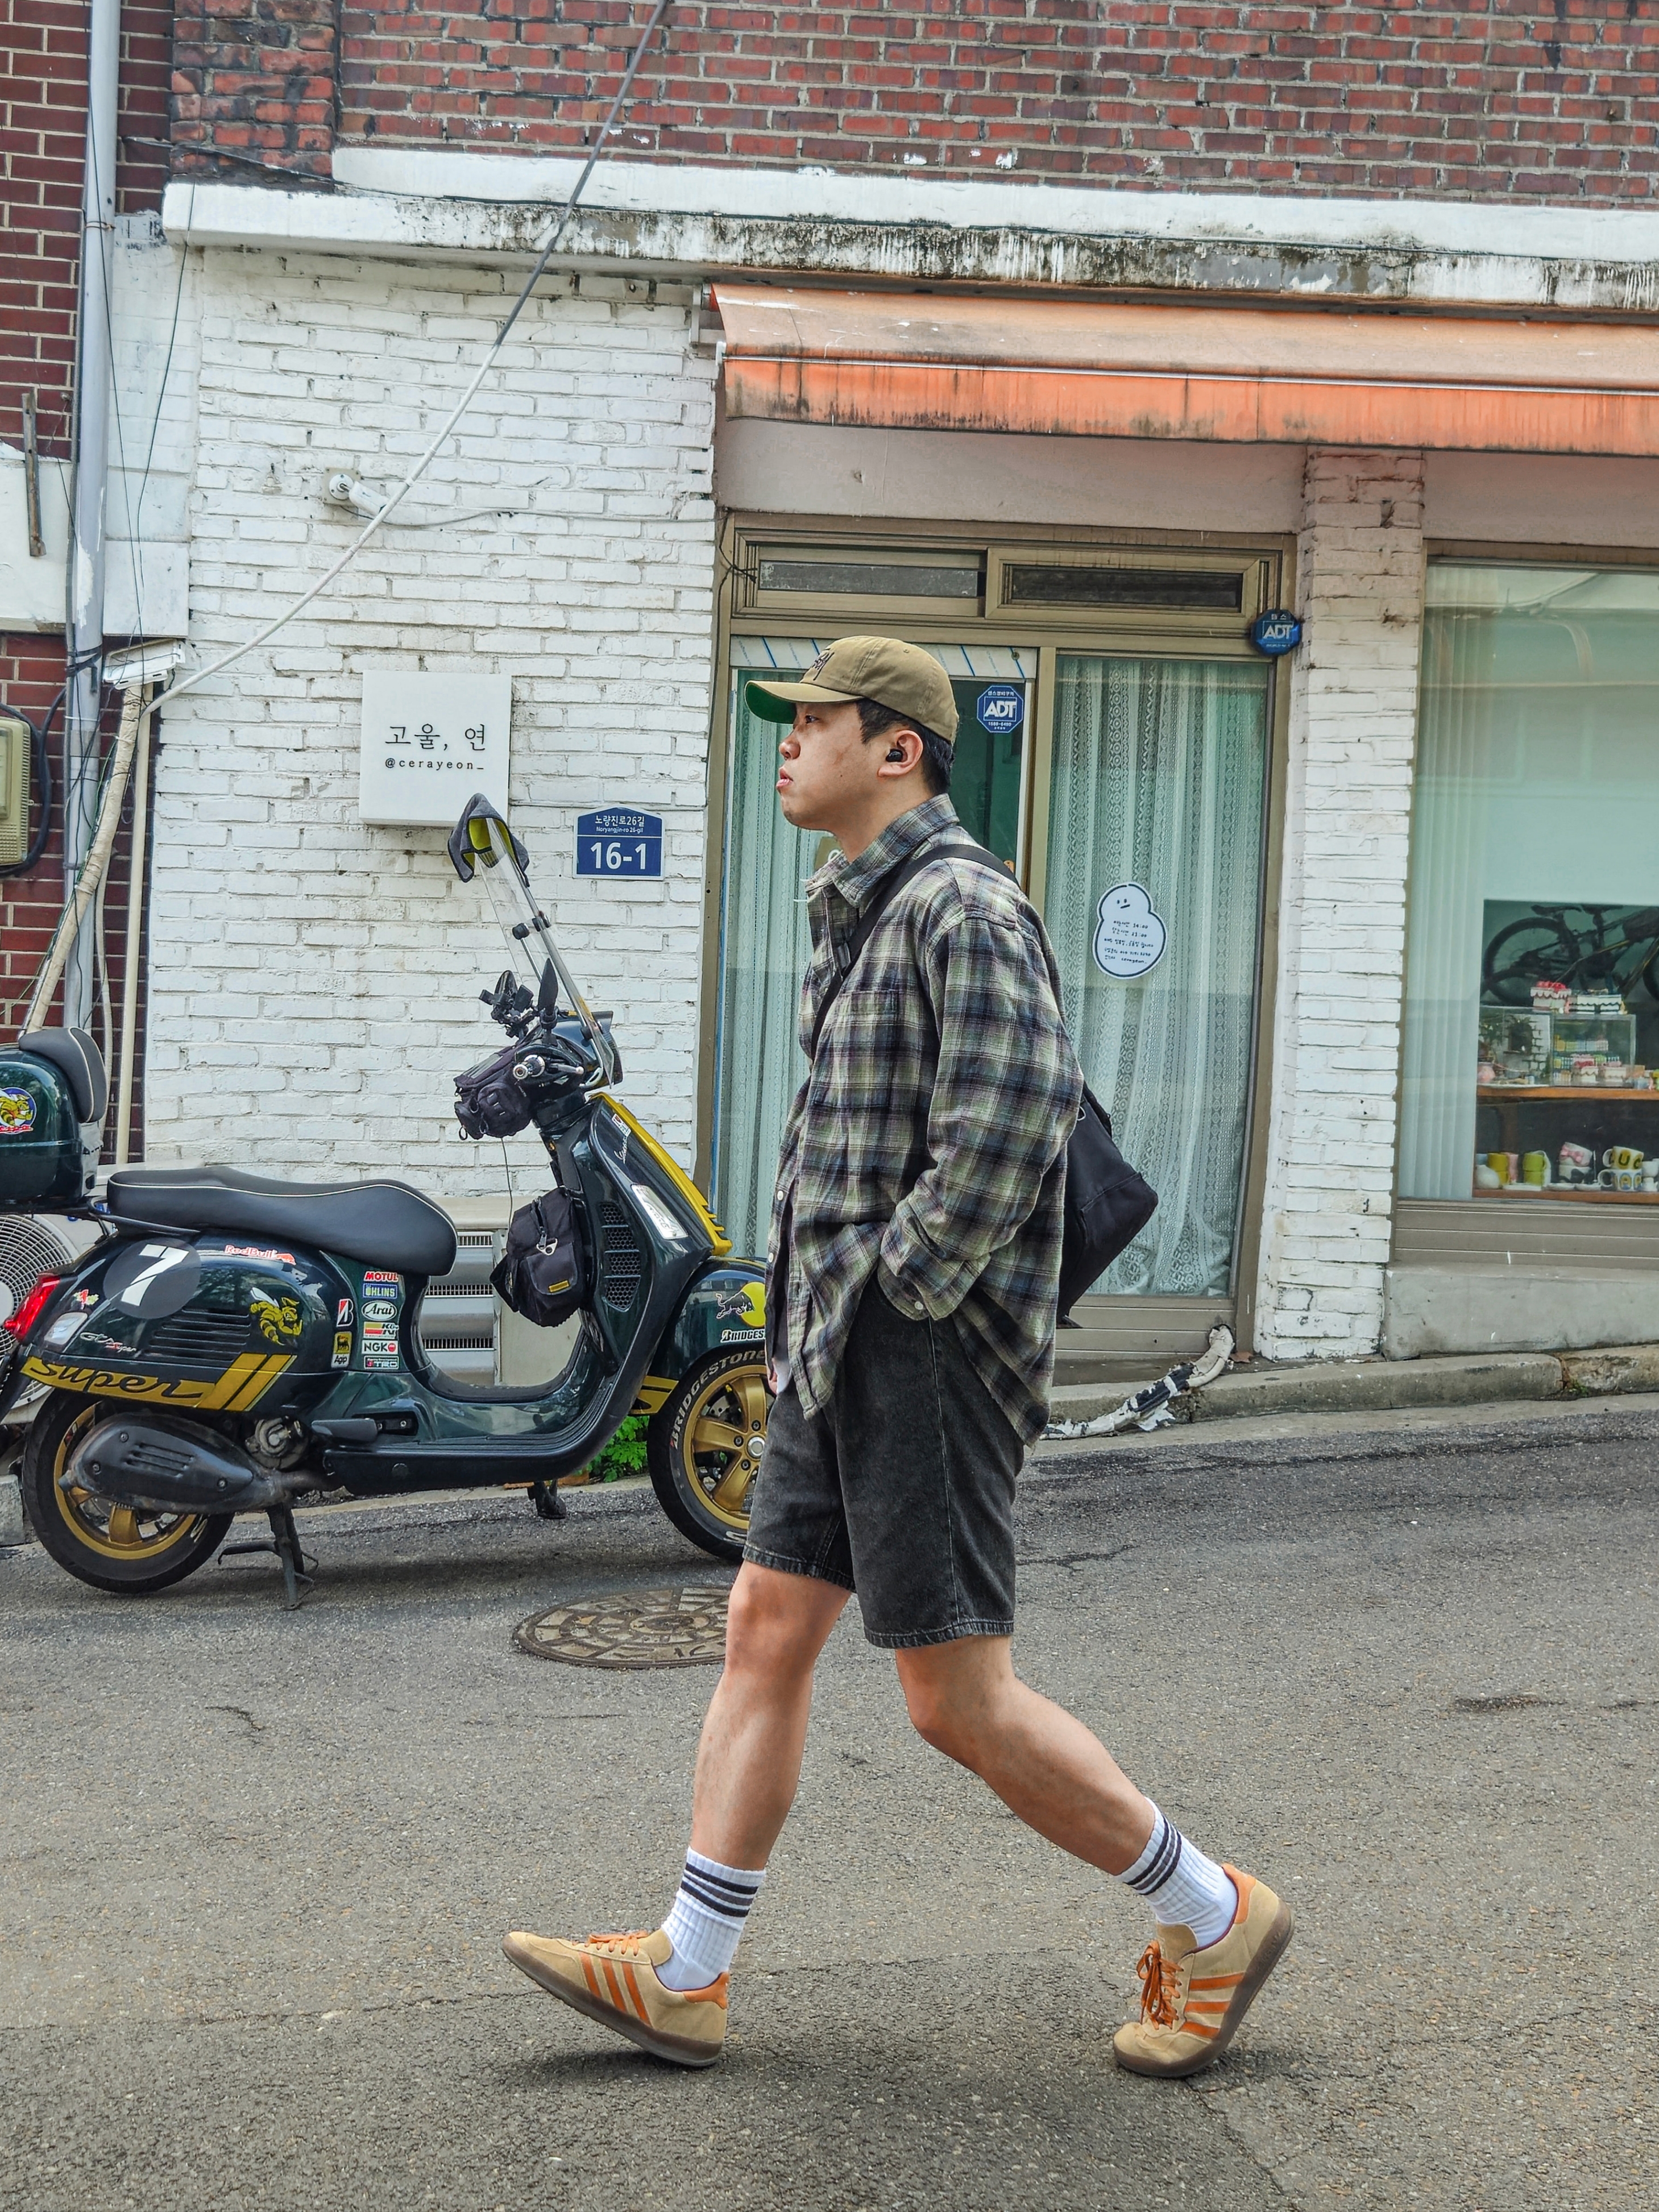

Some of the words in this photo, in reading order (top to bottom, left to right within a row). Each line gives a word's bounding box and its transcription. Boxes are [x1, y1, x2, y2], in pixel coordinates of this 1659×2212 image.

[1263, 625, 1293, 639] ADT
[984, 700, 1017, 717] ADT
[385, 724, 447, 750] 고울,
[465, 724, 485, 750] 연
[385, 758, 484, 770] @cerayeon_
[595, 815, 644, 827] 노량진로26길
[591, 842, 646, 870] 16-1
[121, 1244, 189, 1306] 7
[364, 1271, 398, 1281] MOTUL
[365, 1304, 392, 1314] Arai
[721, 1330, 765, 1342] BRIDGES
[364, 1342, 388, 1352] NGK
[334, 1355, 347, 1364] Agip
